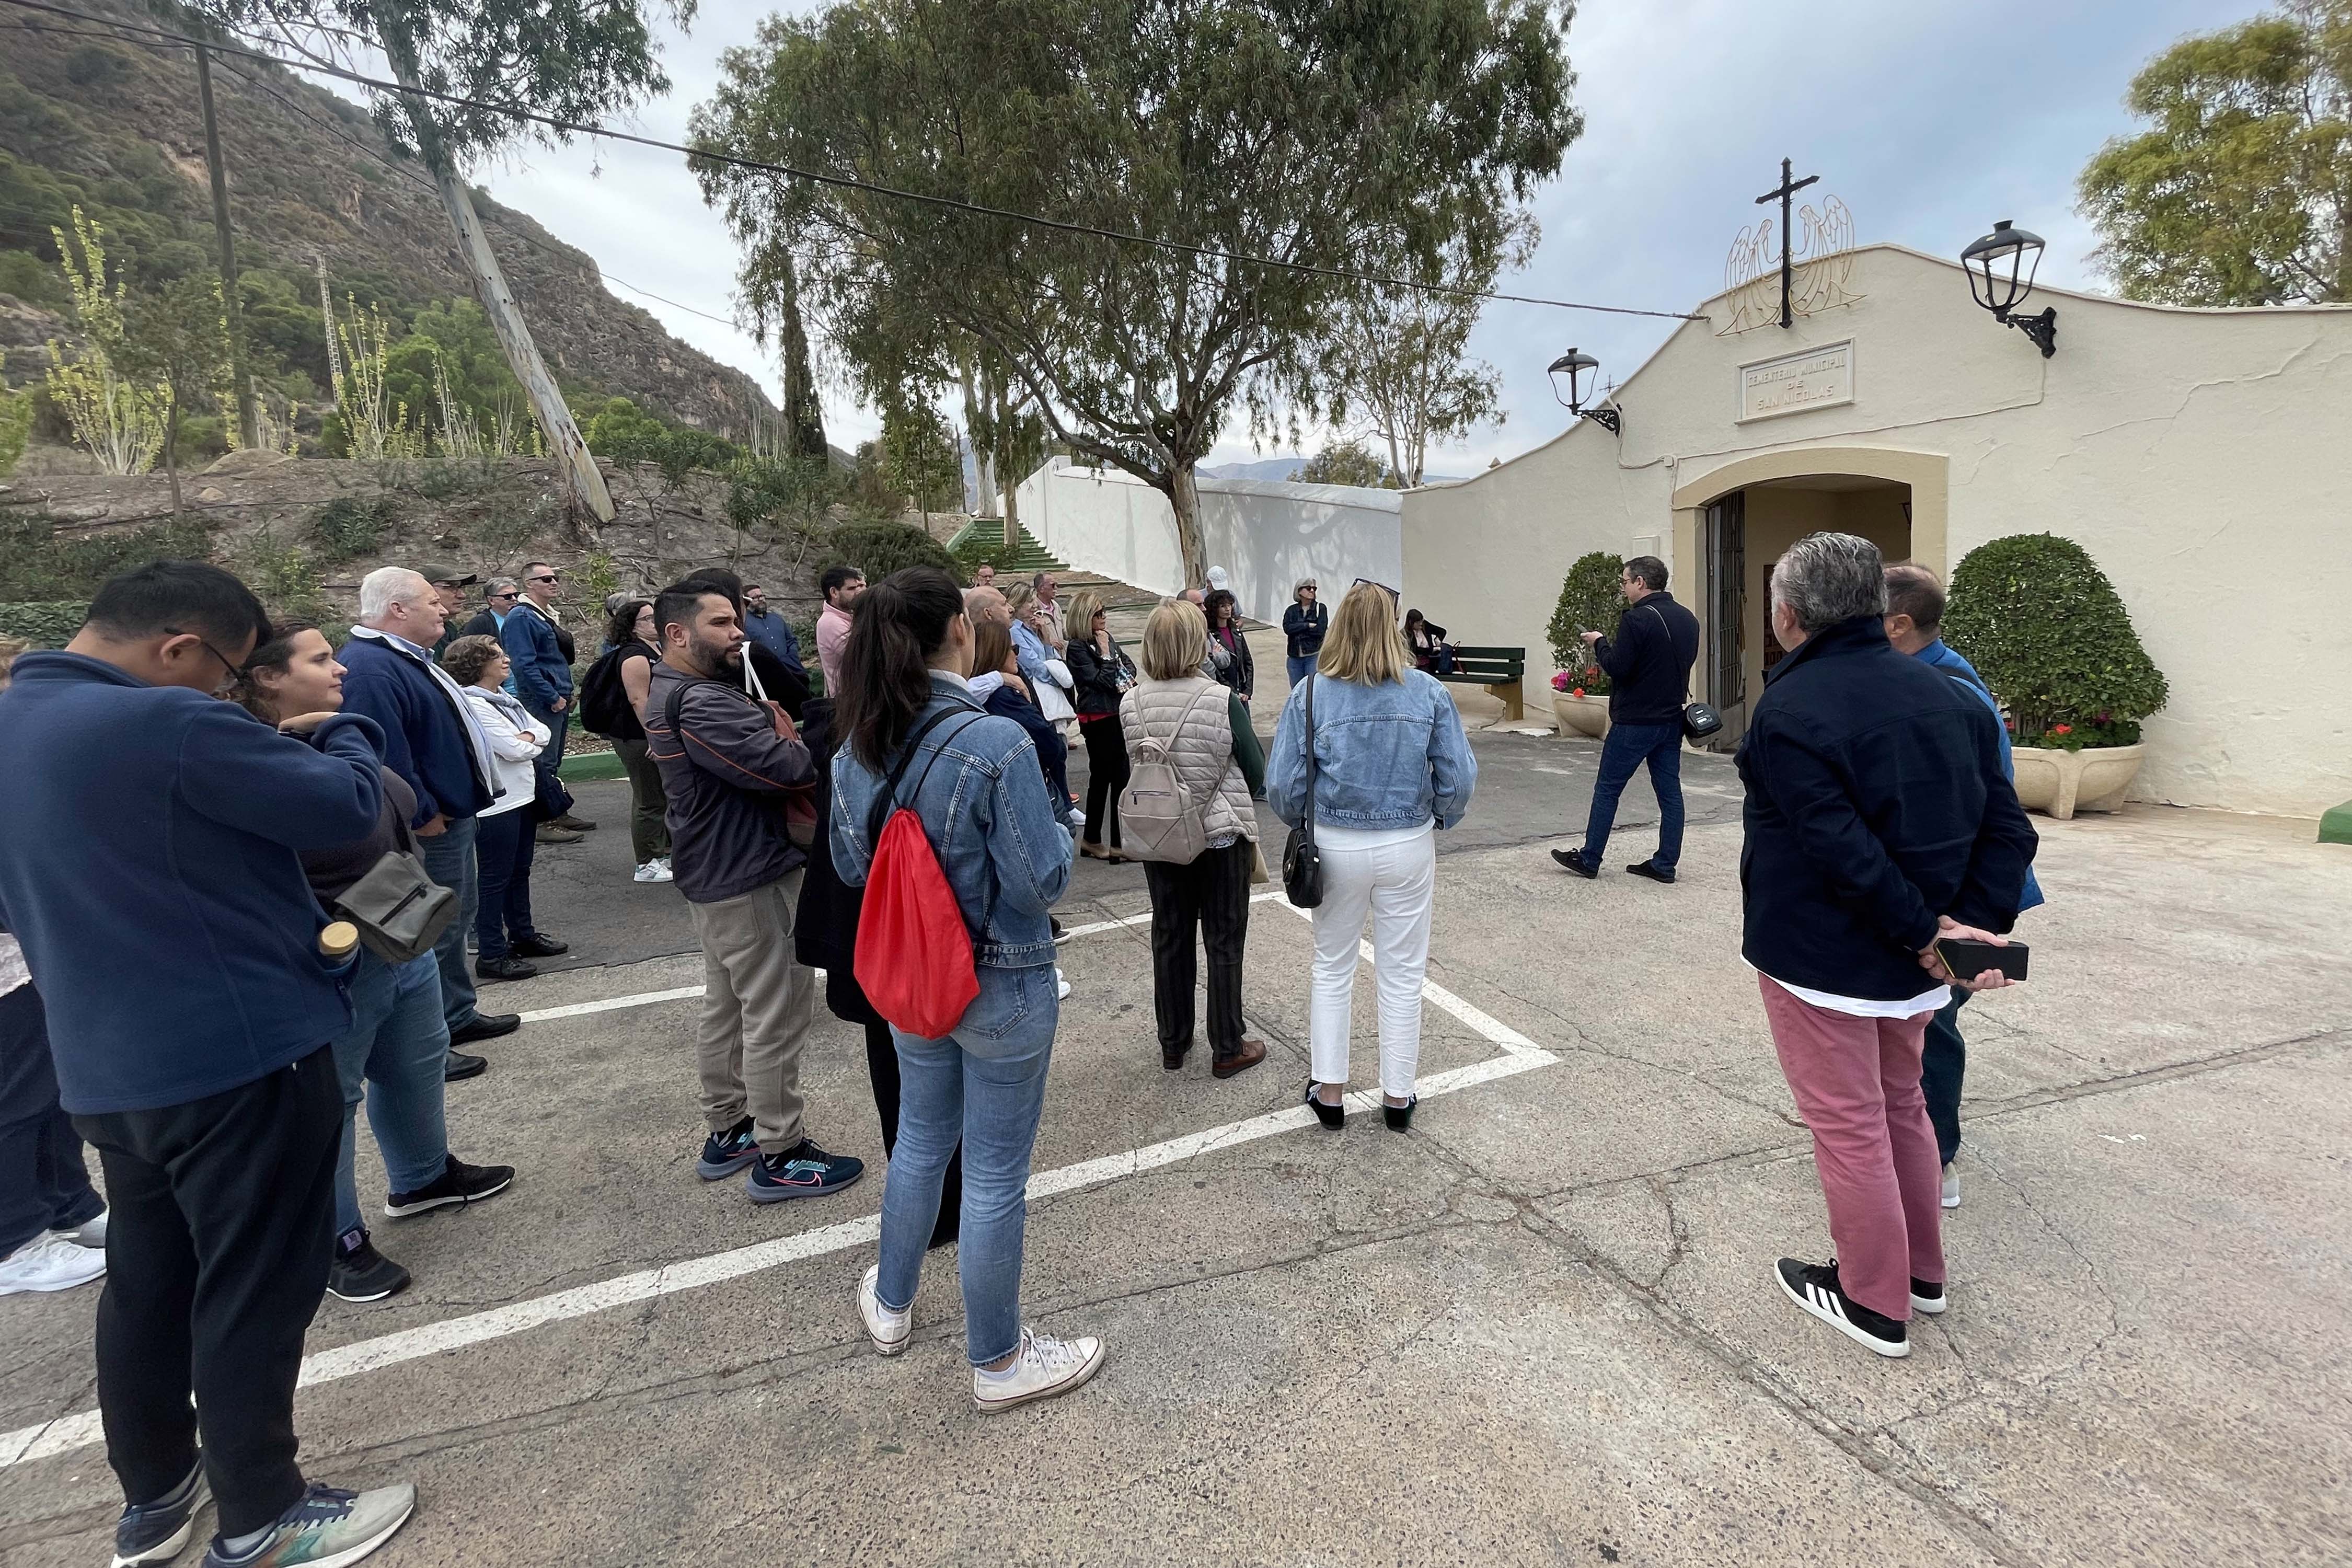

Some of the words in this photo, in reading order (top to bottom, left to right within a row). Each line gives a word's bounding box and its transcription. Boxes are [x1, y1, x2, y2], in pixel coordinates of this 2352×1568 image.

[1748, 366, 1796, 387] CEMENTERIO
[1801, 355, 1844, 375] MUNICIPAL
[1786, 380, 1803, 389] DE
[1757, 397, 1779, 410] SAN
[1784, 385, 1834, 405] NICOLAS
